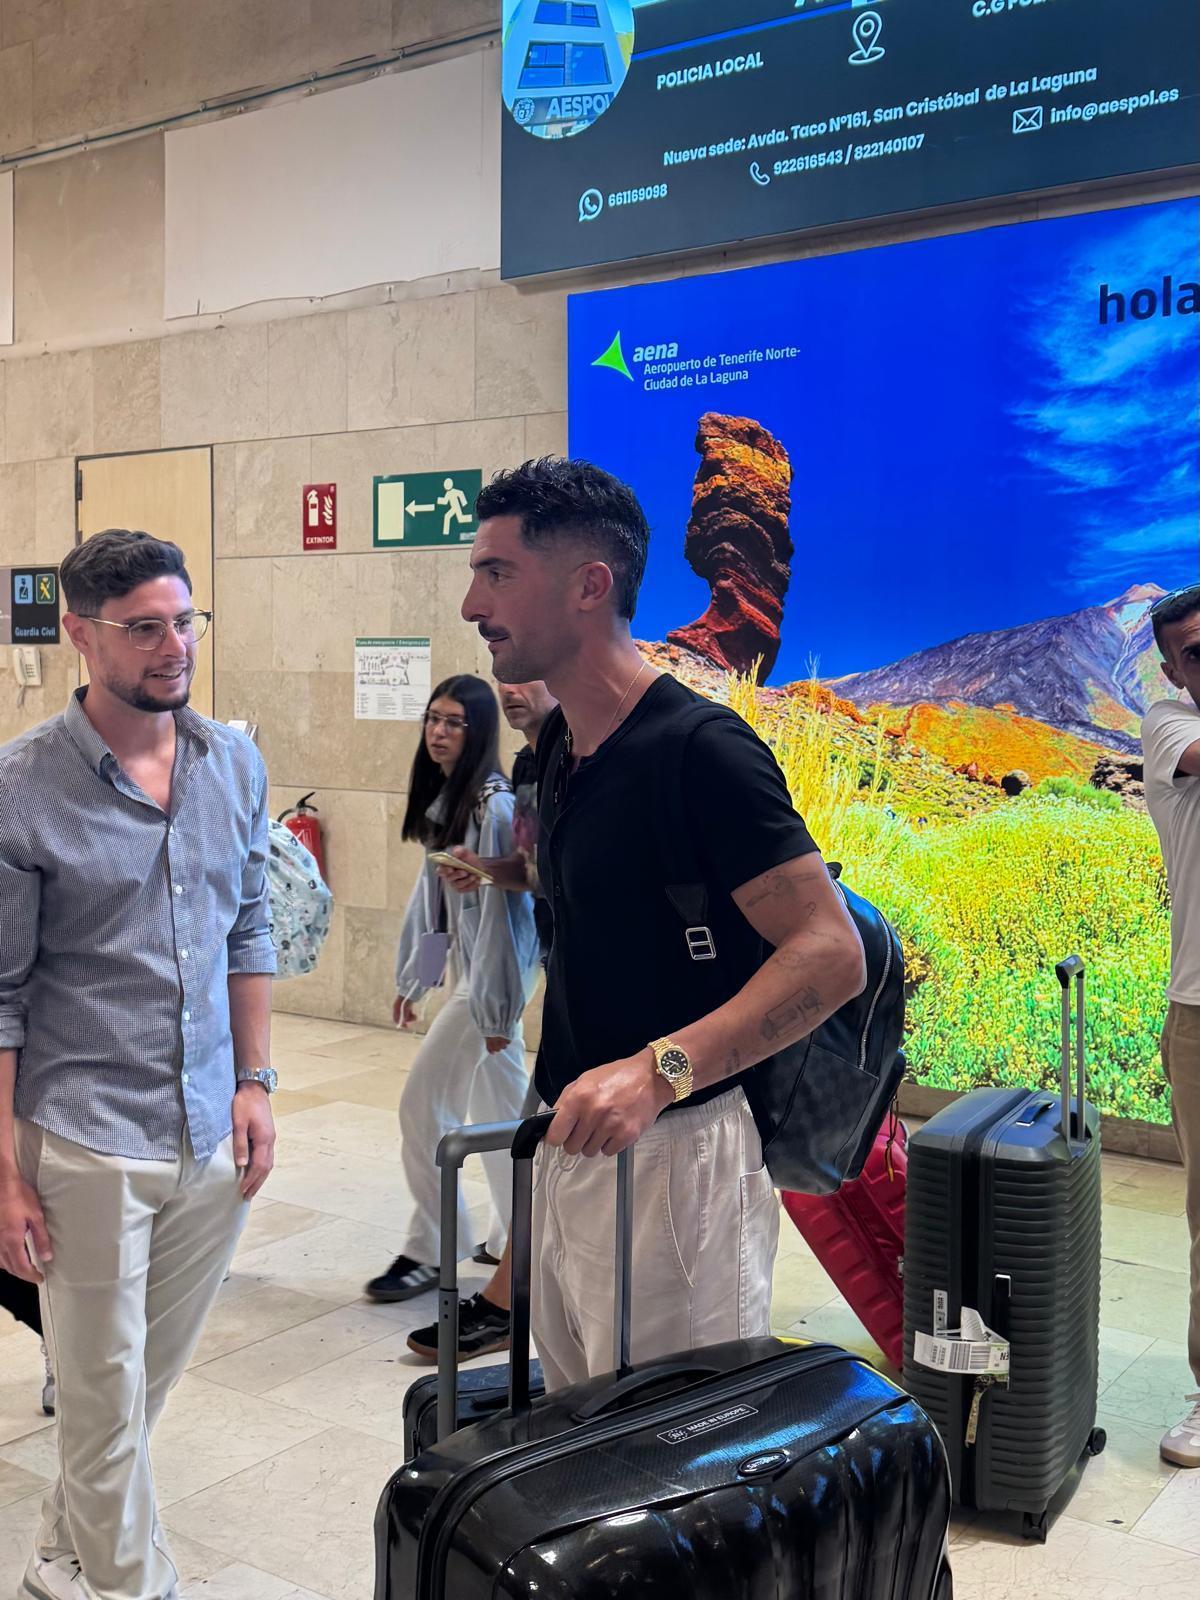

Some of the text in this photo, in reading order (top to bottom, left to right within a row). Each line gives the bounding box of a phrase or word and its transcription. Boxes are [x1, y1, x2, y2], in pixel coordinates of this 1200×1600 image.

[657, 52, 764, 89] POLICIA LOCAL
[664, 143, 707, 166] Nueva
[708, 136, 746, 157] sede:
[747, 127, 789, 150] Avda.
[791, 120, 827, 141] Taco
[873, 106, 903, 124] San
[906, 87, 980, 119] Cristóbal
[985, 85, 1007, 102] de
[1009, 79, 1029, 97] La
[1032, 67, 1098, 93] Laguna
[1050, 87, 1180, 125] info@aespol.es
[773, 133, 925, 176] 922616543 / 822140107
[608, 183, 668, 208] 661169098
[1099, 275, 1200, 325] hola
[633, 342, 678, 362] aena
[644, 347, 801, 375] Aeropuerto de Tenerife Norte-
[644, 370, 748, 391] Ciudad de La Laguna
[306, 536, 334, 545] EXTINTOR
[15, 626, 56, 636] Guardia Civil
[686, 1420, 709, 1431] MADE
[718, 1407, 745, 1420] EUROPE
